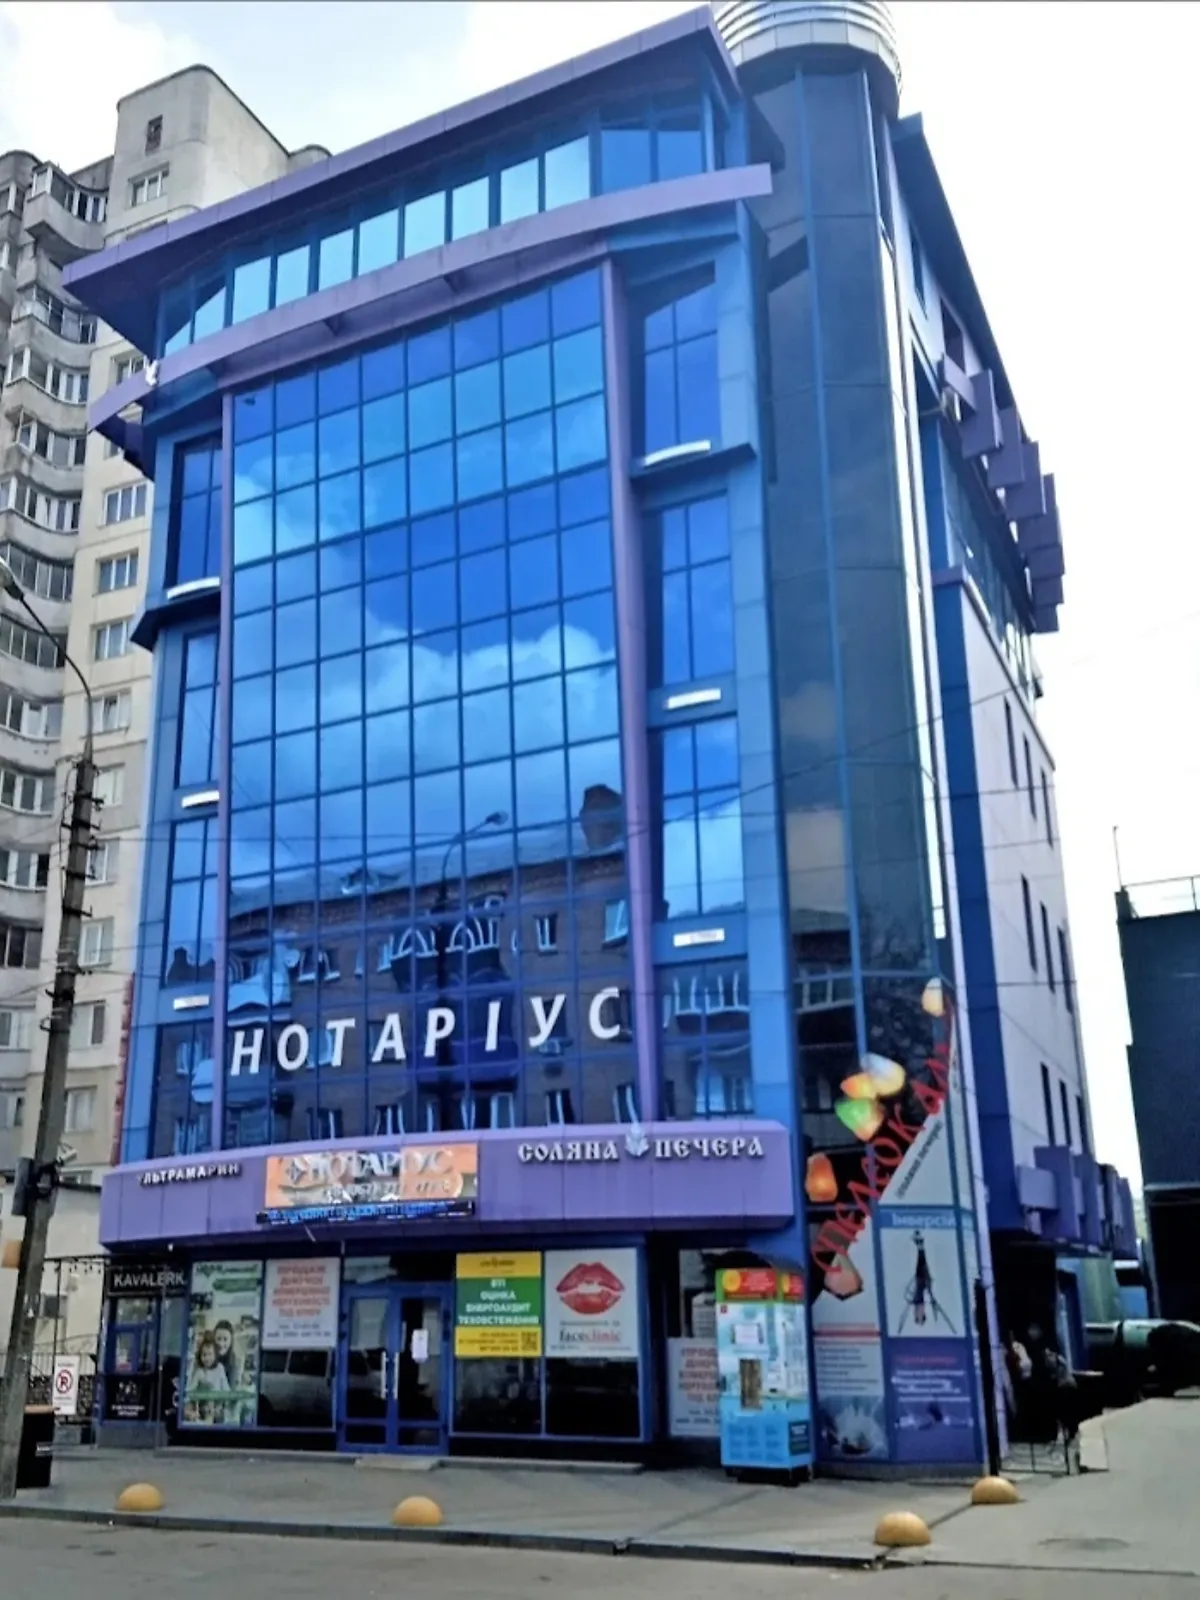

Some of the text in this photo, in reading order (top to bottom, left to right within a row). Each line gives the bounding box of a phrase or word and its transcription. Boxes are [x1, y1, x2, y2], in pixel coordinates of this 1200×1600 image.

[230, 986, 621, 1076] НОТАРІУС
[517, 1136, 765, 1163] СОЛЯНА ПЕЧЕРА
[137, 1163, 240, 1185] УЛЬТРАМАРИН
